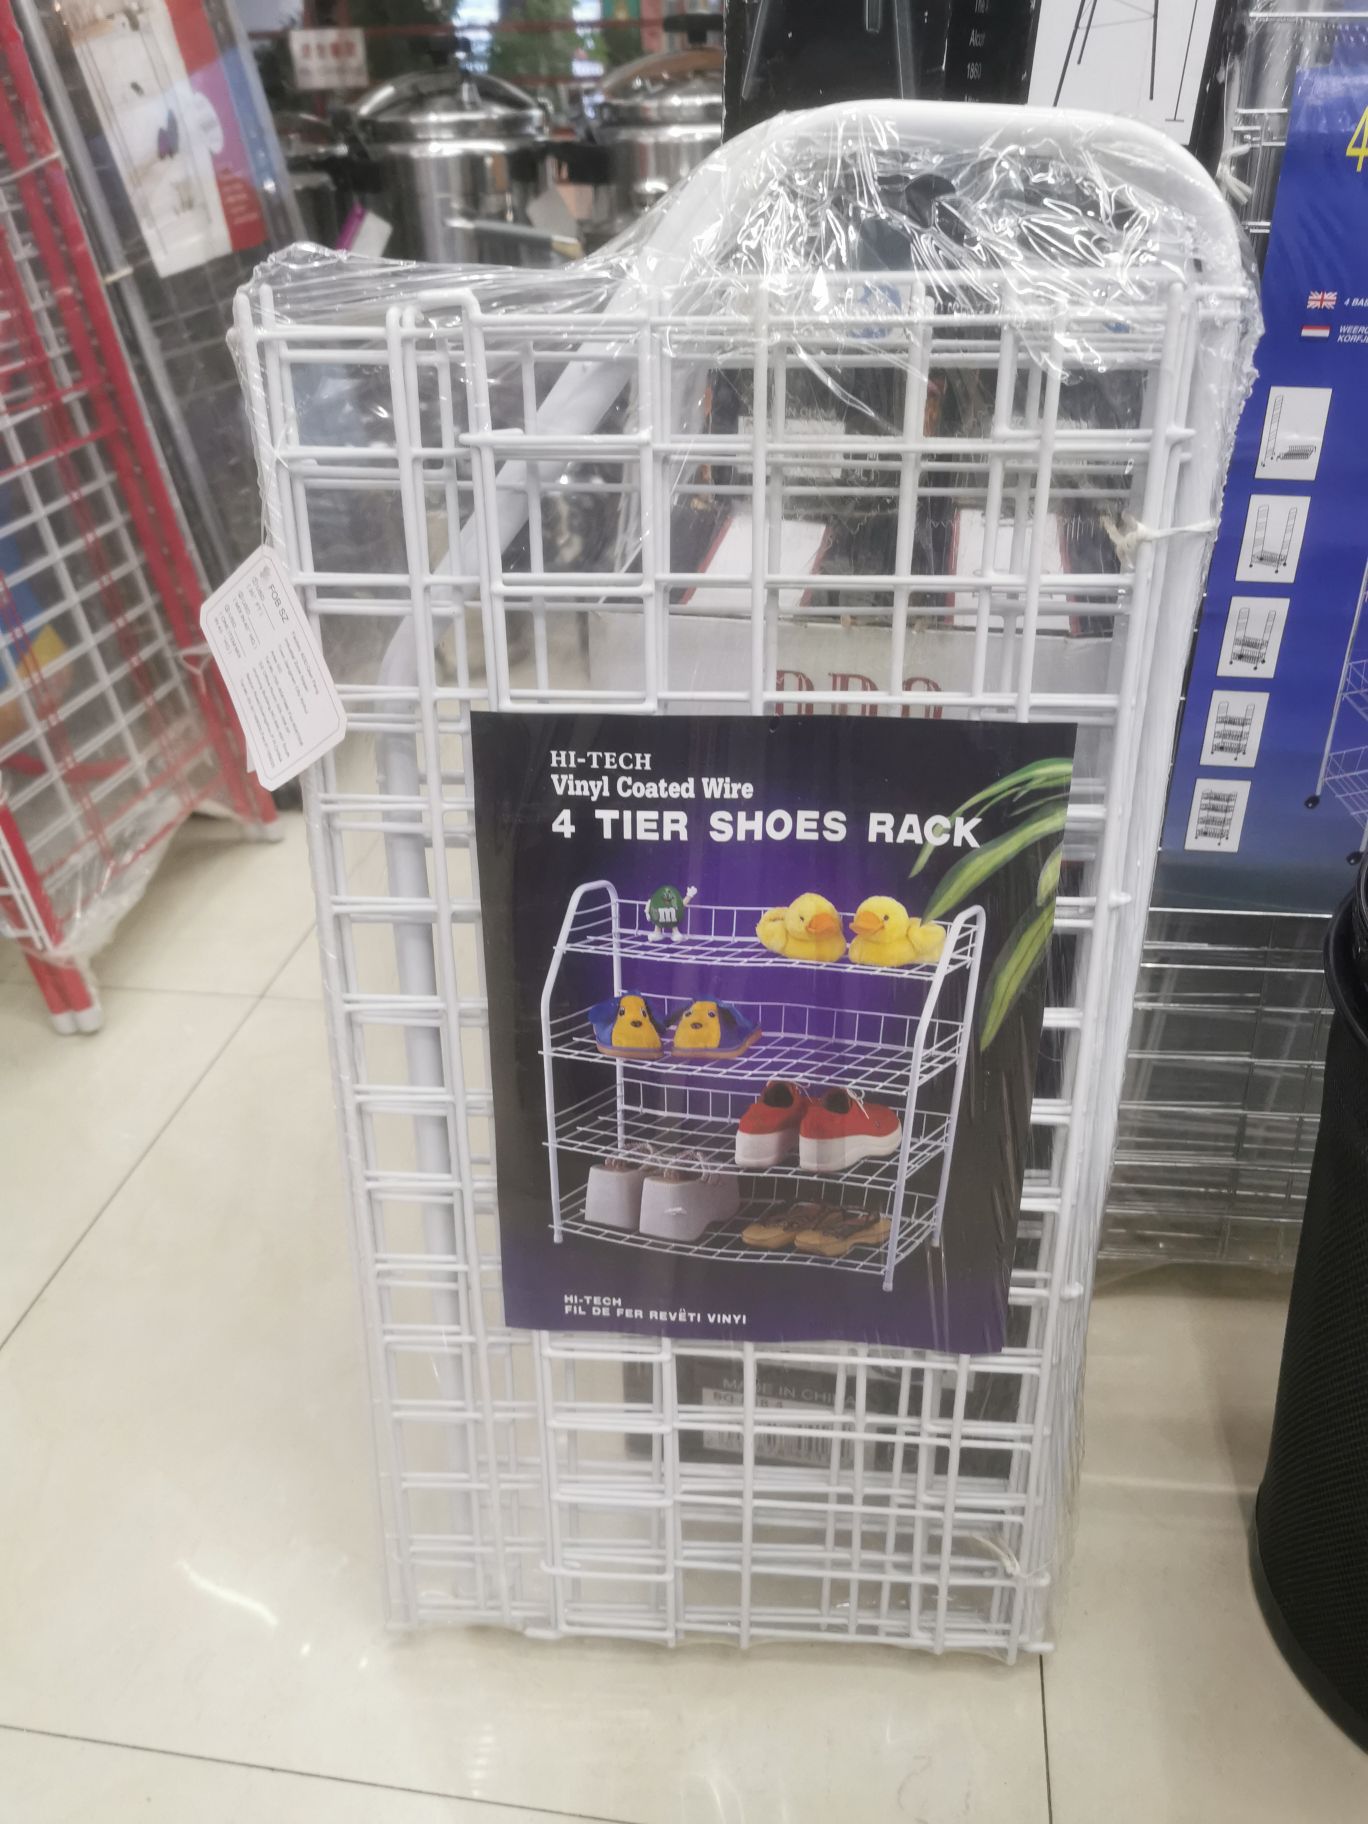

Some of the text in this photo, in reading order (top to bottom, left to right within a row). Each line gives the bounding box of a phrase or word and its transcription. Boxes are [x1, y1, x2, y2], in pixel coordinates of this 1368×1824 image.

[1346, 105, 1368, 173] 4
[268, 583, 290, 624] FOB SZ
[550, 750, 652, 770] HI-TECH
[550, 774, 754, 801] Vinyl Coated Wire
[551, 808, 983, 848] 4 TIER SHOES RACK
[564, 1294, 622, 1307] HI-TECH
[564, 1305, 586, 1316] FIL
[592, 1306, 611, 1317] DE
[616, 1308, 644, 1319] FER
[800, 1388, 856, 1405] CHIA
